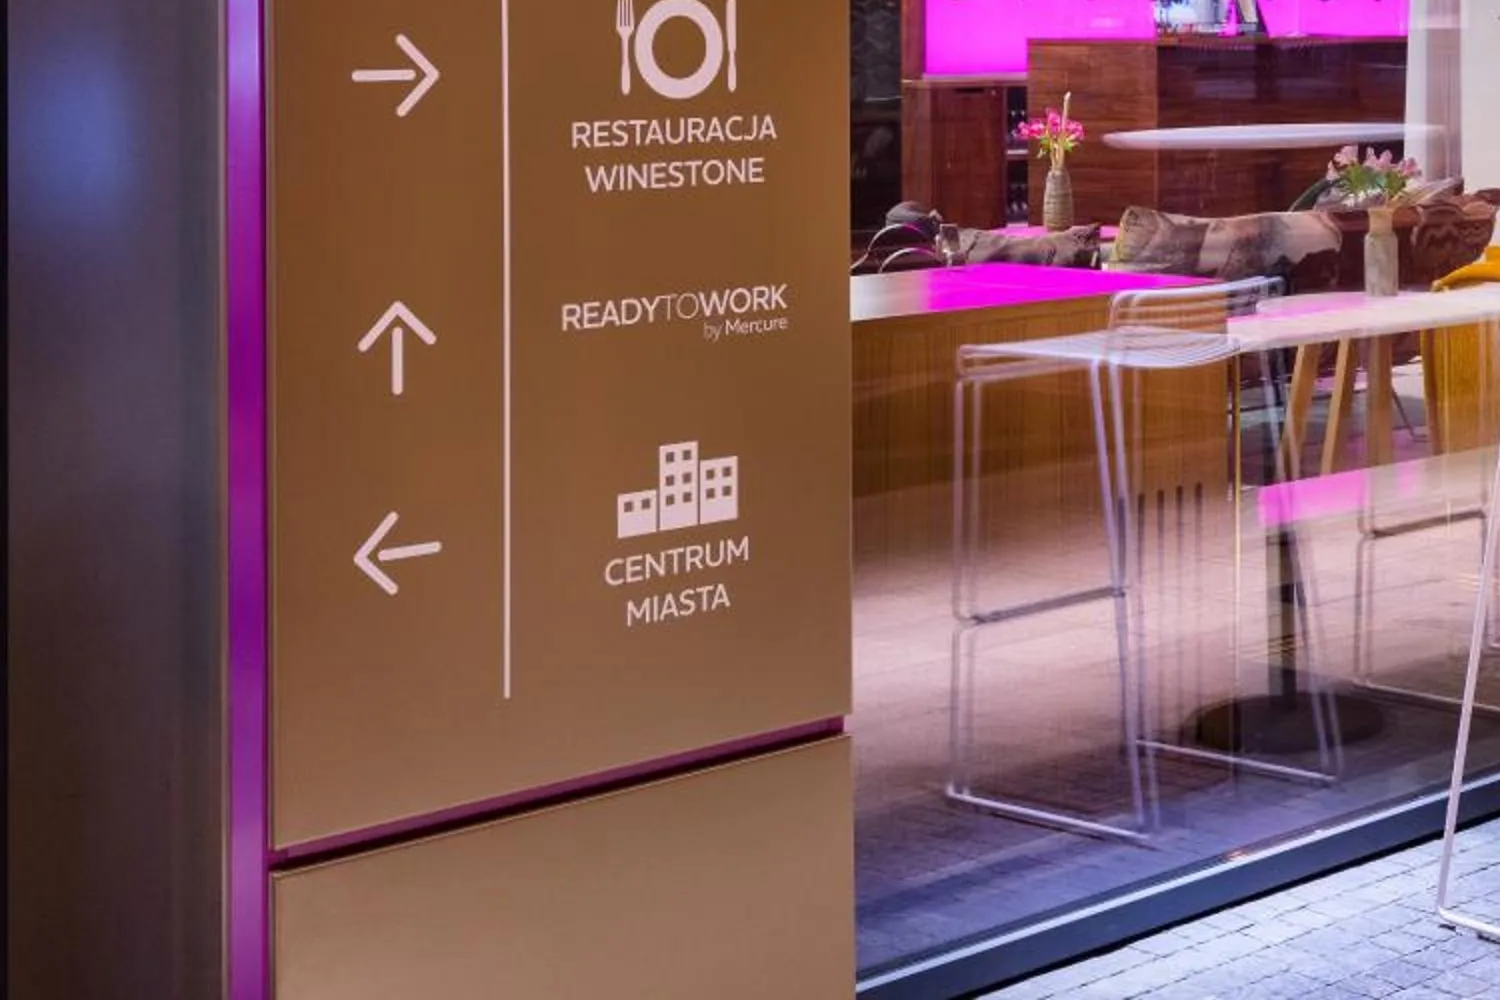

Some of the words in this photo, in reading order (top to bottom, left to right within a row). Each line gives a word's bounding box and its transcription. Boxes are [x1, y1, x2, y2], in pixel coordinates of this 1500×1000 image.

[571, 114, 777, 149] RESTAURACJA
[585, 157, 765, 193] WINESTONE
[703, 321, 723, 342] by
[725, 315, 789, 336] Mercure
[604, 536, 750, 586] CENTRUM
[626, 584, 731, 627] MIASTA
